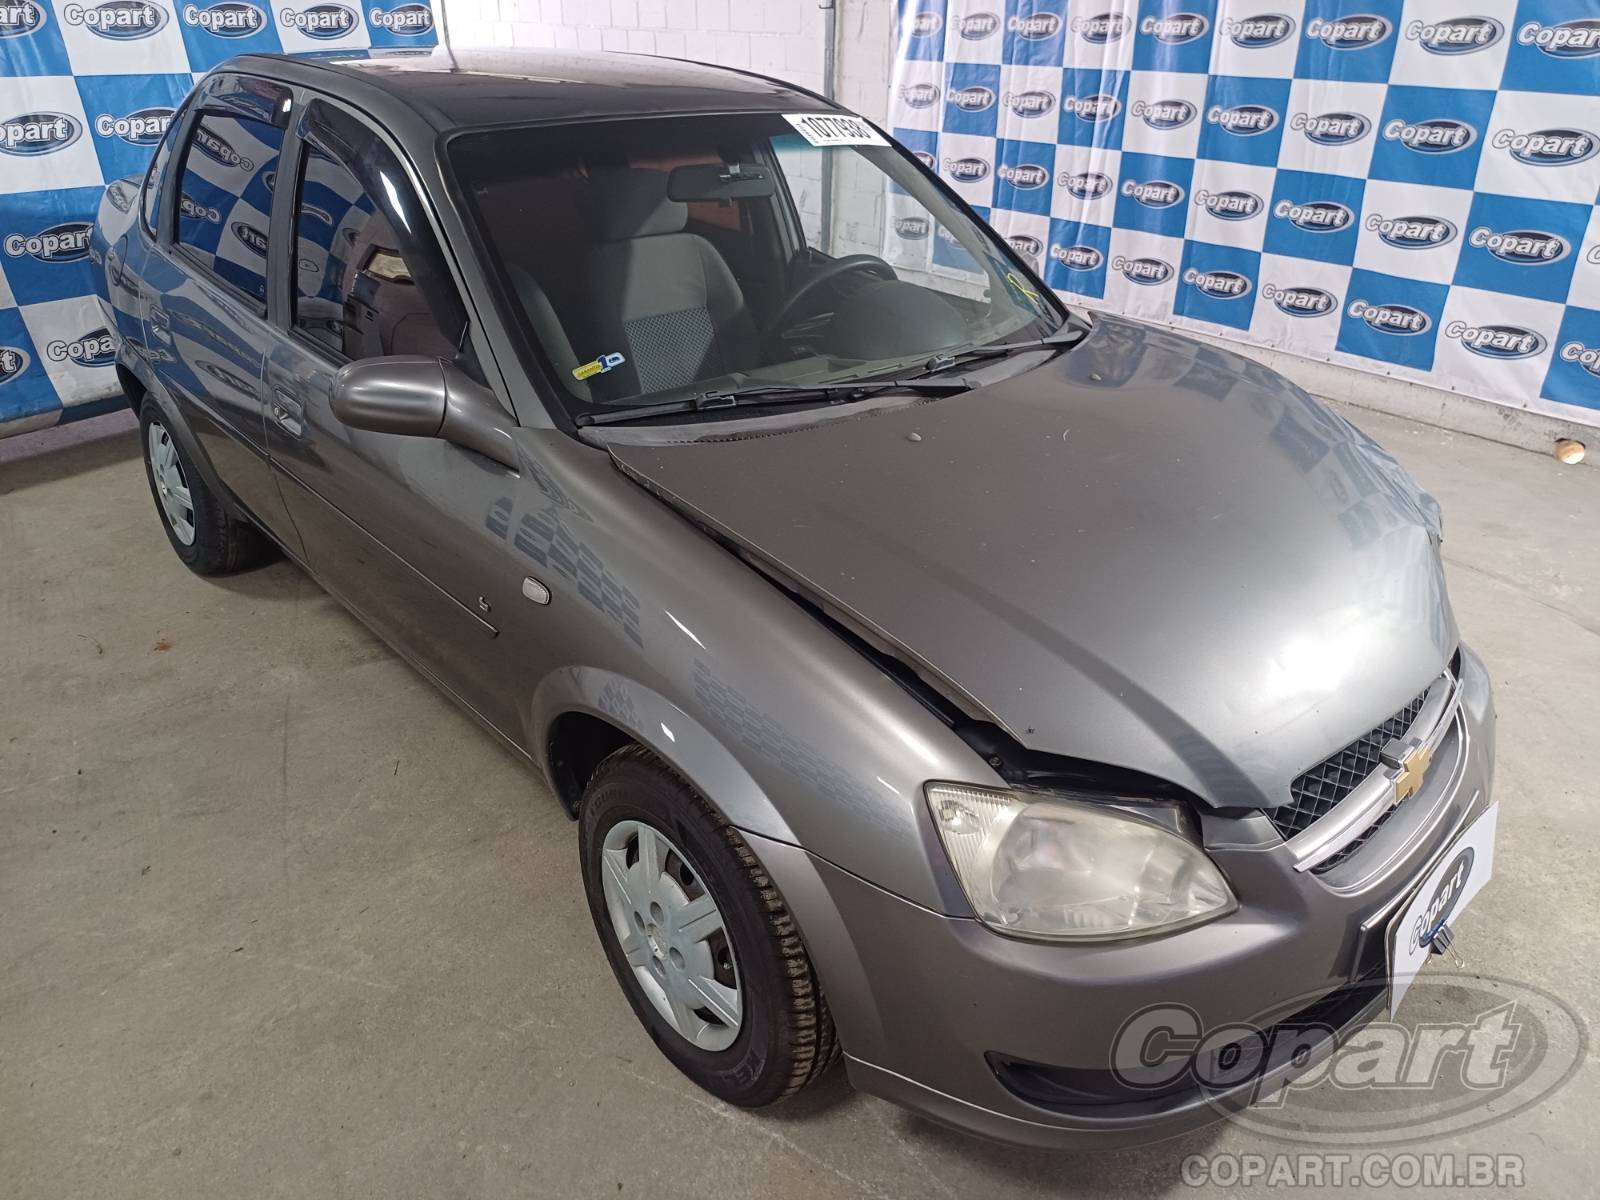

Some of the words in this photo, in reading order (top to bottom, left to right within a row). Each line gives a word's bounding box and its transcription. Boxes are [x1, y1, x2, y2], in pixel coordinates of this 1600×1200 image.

[0, 4, 35, 25] art
[64, 4, 155, 30] Copart
[183, 4, 258, 30] Copart
[280, 7, 351, 31] Copart
[370, 8, 431, 28] Copart
[1008, 13, 1056, 38] Copart
[1071, 15, 1124, 39] Copart
[1140, 16, 1204, 38] Copart
[1221, 16, 1290, 42] Copart
[1307, 15, 1385, 43] Copart
[1405, 18, 1495, 45] Copart
[1518, 21, 1600, 51] Copar
[947, 88, 991, 109] Copart
[1064, 96, 1119, 118] Copart
[1131, 101, 1190, 124] Copart
[1207, 104, 1273, 129] Copart
[1290, 112, 1364, 139] Copart
[0, 117, 68, 148] part
[95, 113, 174, 140] Copar
[1383, 119, 1468, 148] Copart
[1491, 129, 1589, 158] Copart
[943, 157, 987, 177] Copart
[998, 163, 1043, 184] Copart
[1057, 172, 1107, 195] Copart
[1121, 180, 1179, 202] Copart
[1194, 189, 1258, 214] Copart
[1274, 200, 1346, 227] Copart
[1365, 213, 1448, 242] Copart
[1050, 244, 1097, 267] Copart
[1469, 226, 1562, 259] Copart
[1112, 256, 1164, 279] Copart
[1183, 267, 1247, 295] Copart
[1262, 284, 1331, 312] Copart
[1347, 301, 1424, 331] Copart
[48, 334, 116, 361] Copa
[1445, 321, 1536, 354] Copart
[1409, 861, 1464, 956] Copart
